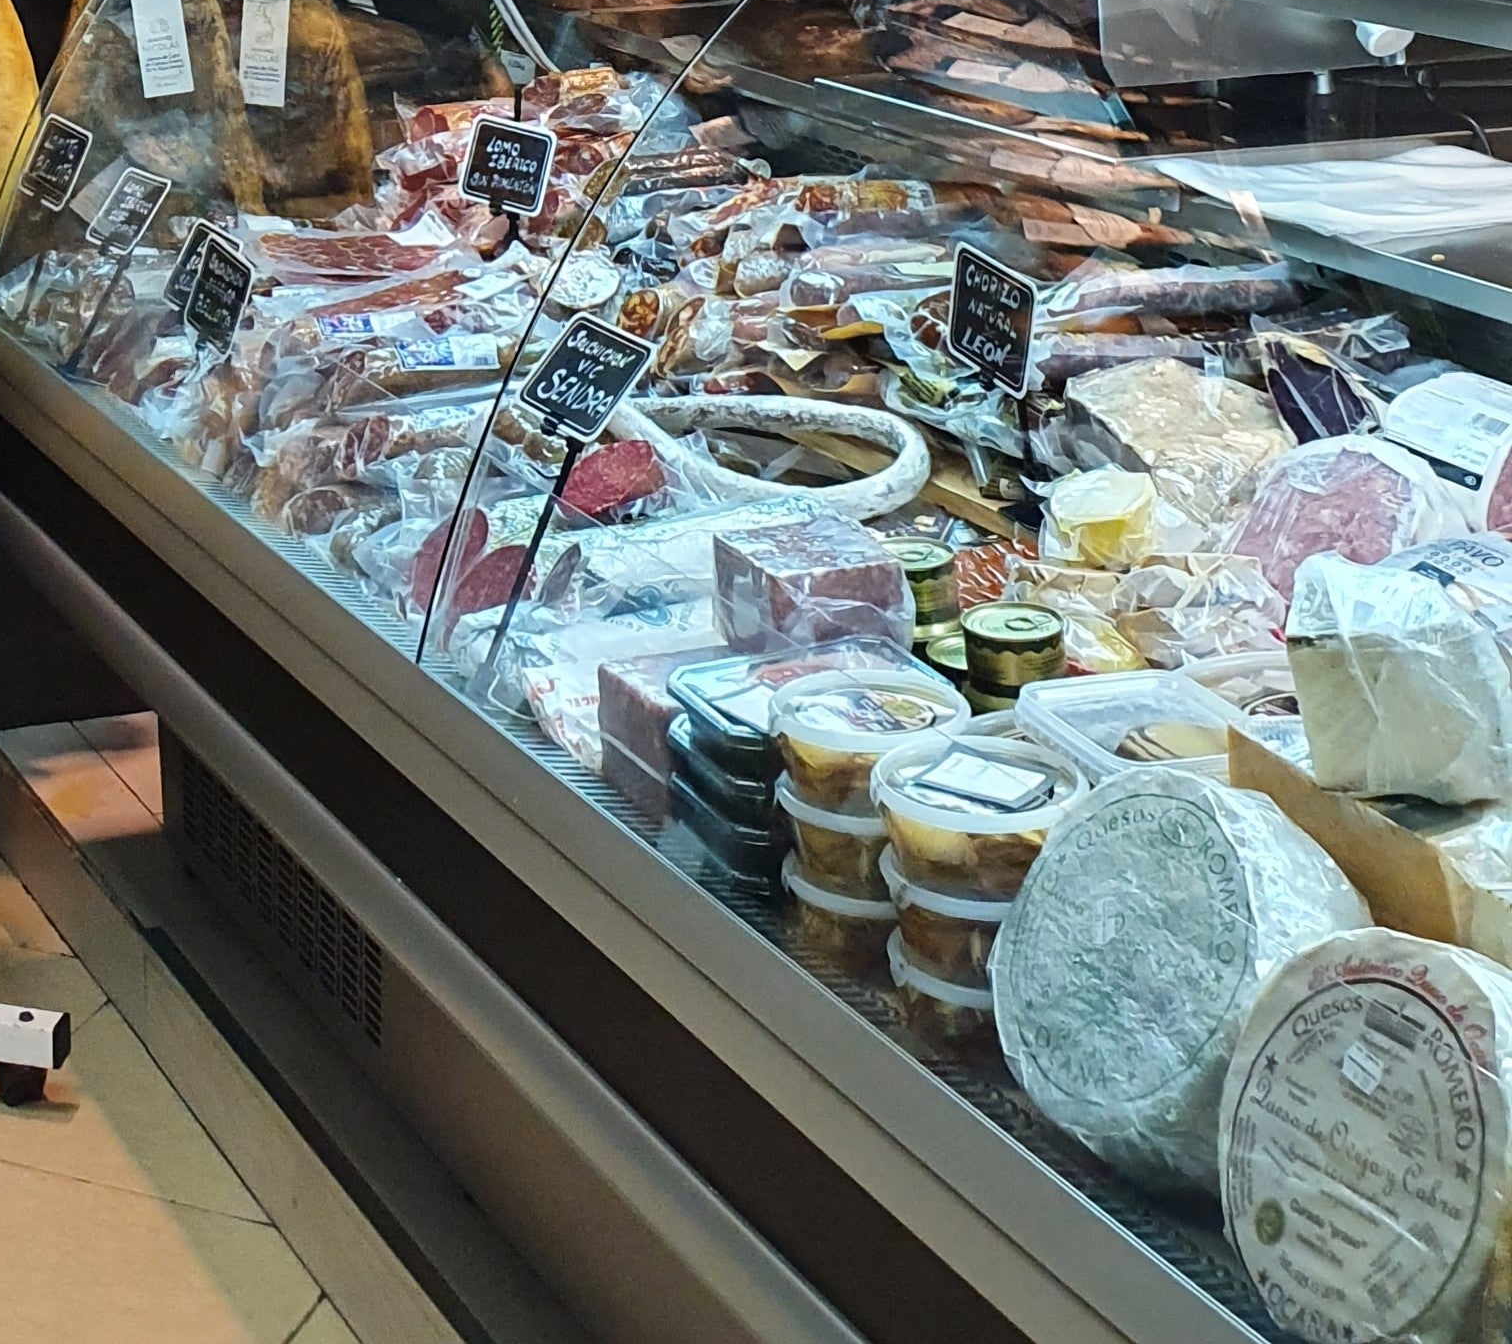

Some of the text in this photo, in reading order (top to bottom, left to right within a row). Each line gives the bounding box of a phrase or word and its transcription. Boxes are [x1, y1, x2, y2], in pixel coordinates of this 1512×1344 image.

[485, 135, 521, 157] LOMO
[966, 263, 1021, 310] CHORIZO
[967, 298, 1018, 340] NATURAL
[576, 358, 605, 380] VIC
[536, 368, 615, 419] SENDRA
[1076, 810, 1156, 851] Quesos
[1198, 835, 1237, 965] ROMERO
[1291, 994, 1365, 1037] Quesos
[1428, 1027, 1476, 1151] ROMERO
